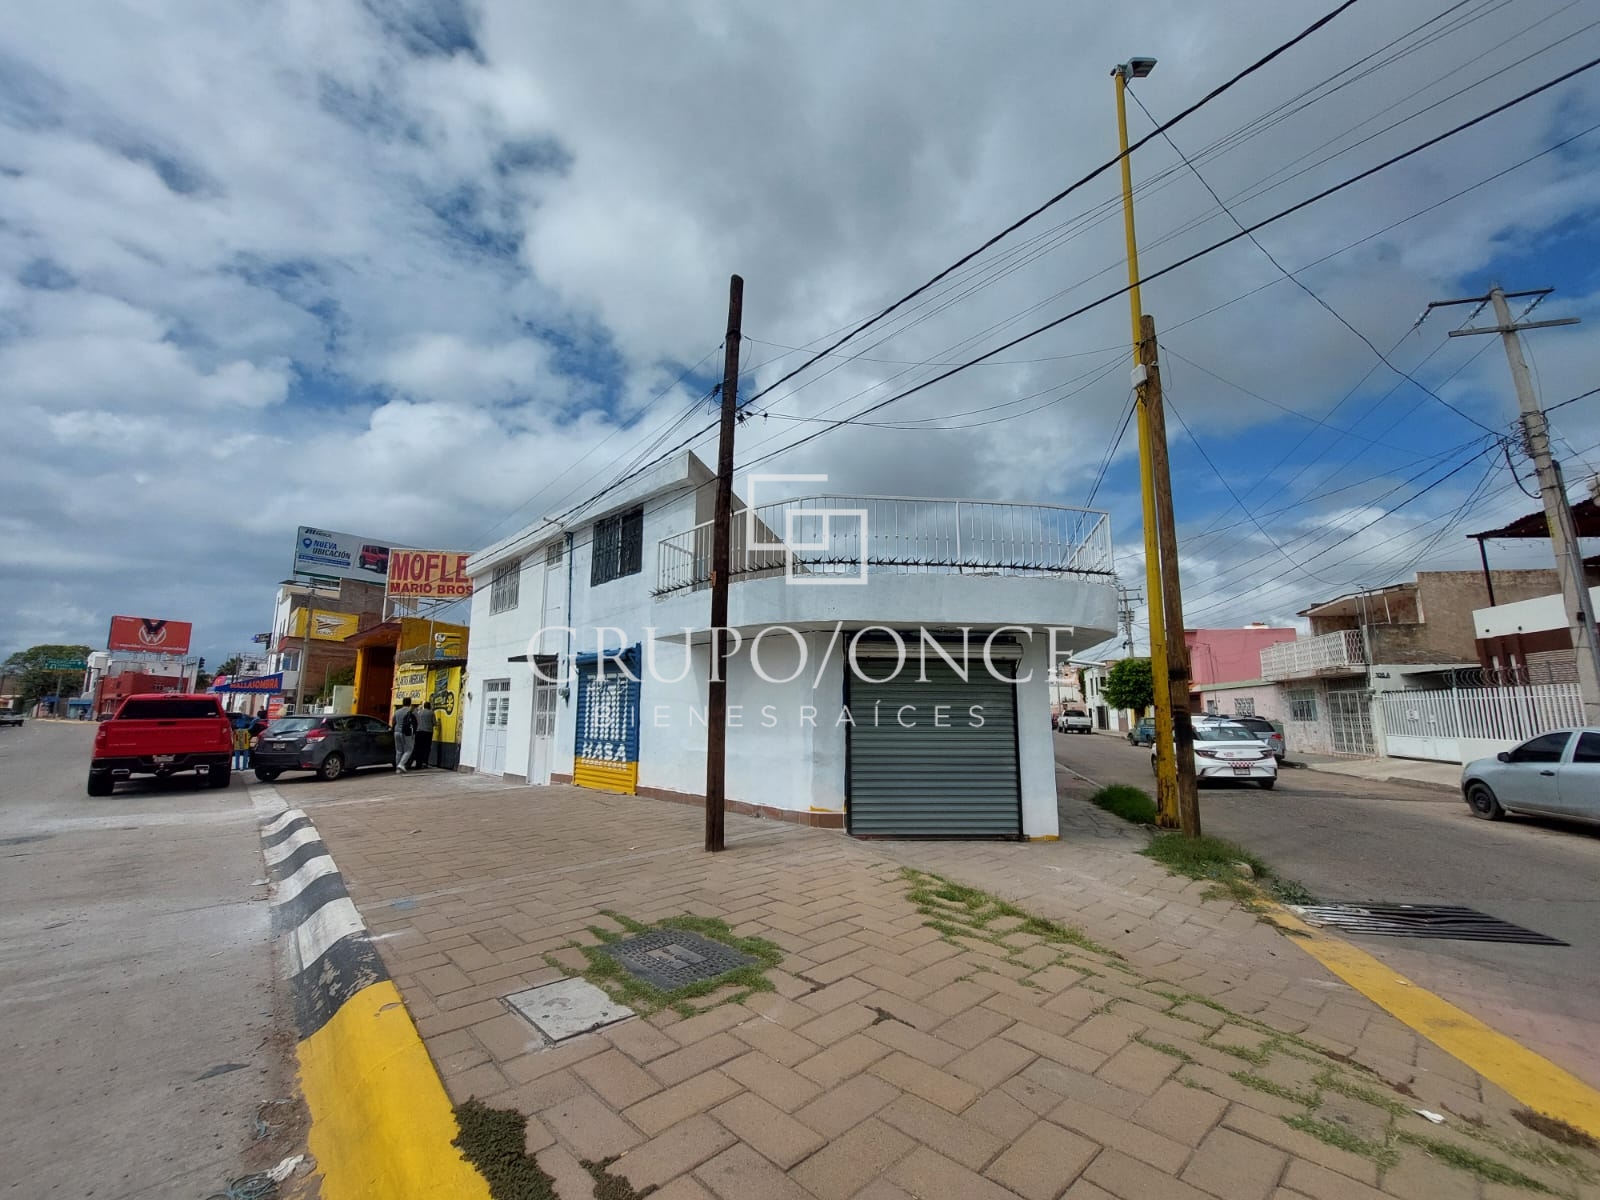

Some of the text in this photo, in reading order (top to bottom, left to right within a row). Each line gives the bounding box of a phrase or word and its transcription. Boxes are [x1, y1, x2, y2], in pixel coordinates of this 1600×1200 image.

[314, 540, 337, 550] NUEVA
[312, 548, 351, 559] UBICACIÓN
[391, 553, 473, 583] MOFLE
[390, 583, 473, 595] MARIO BROS
